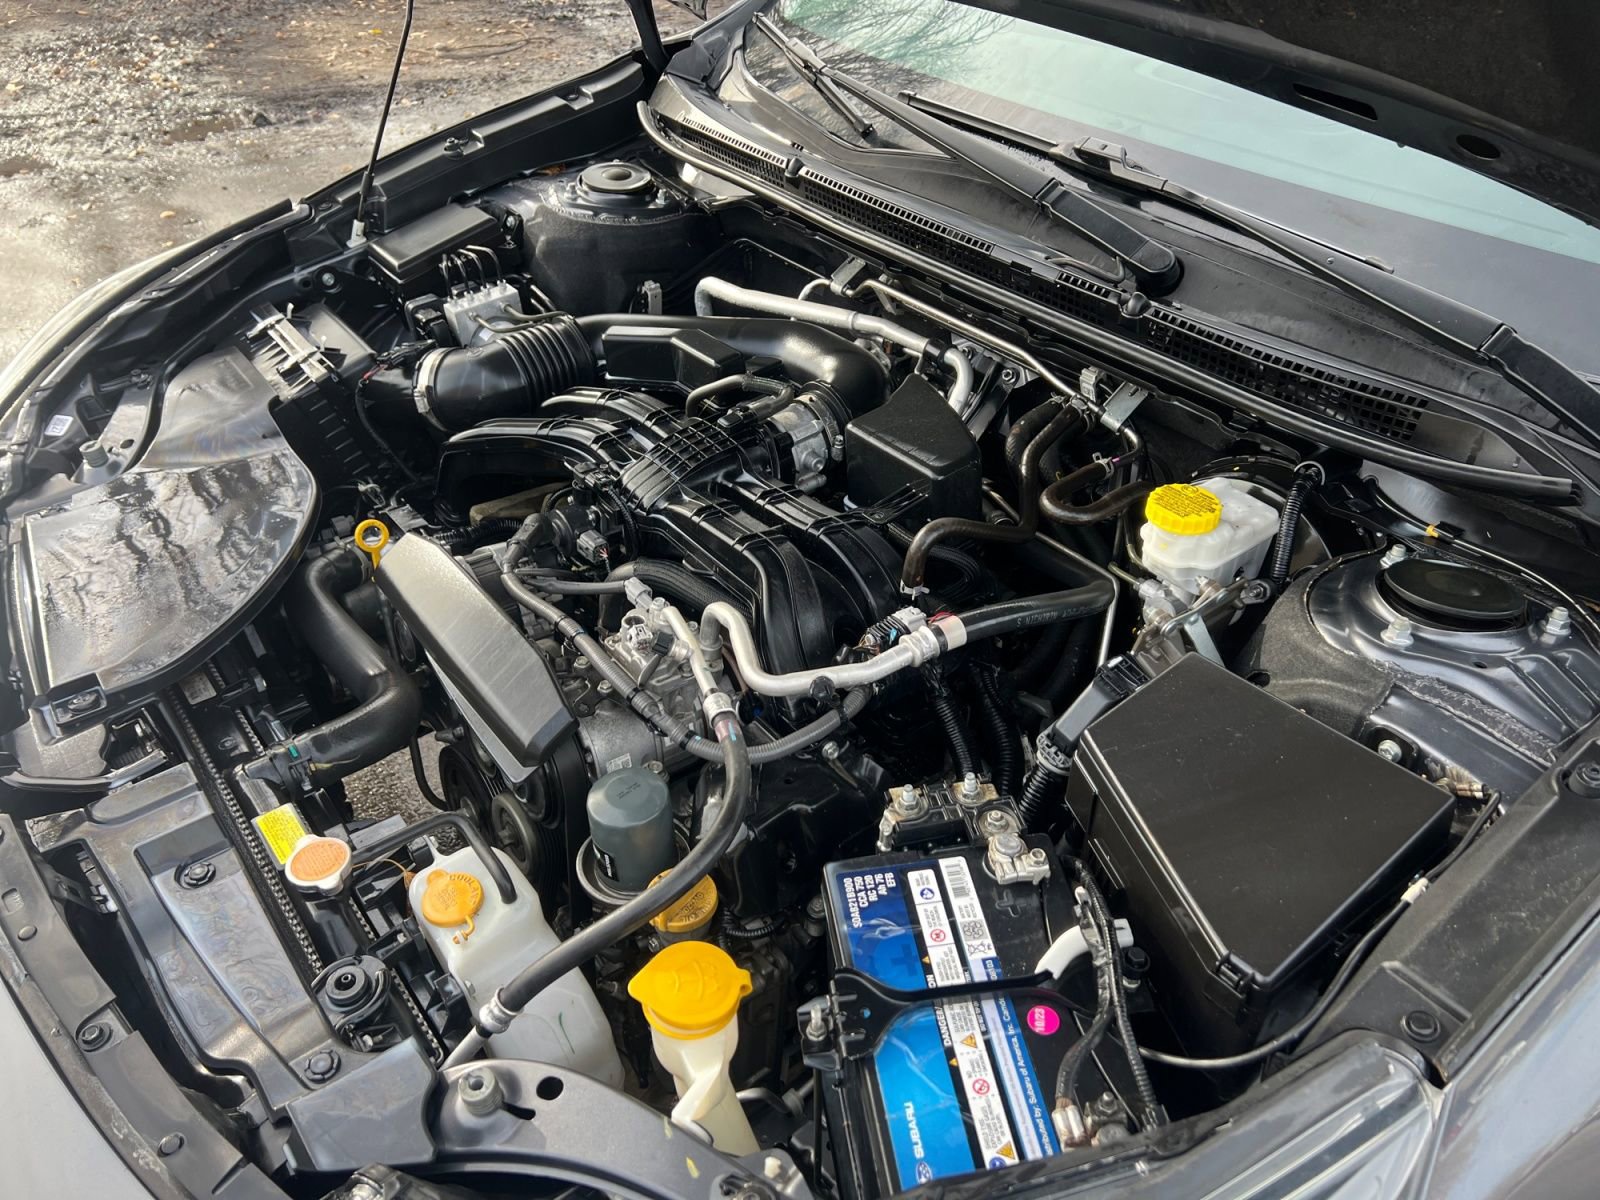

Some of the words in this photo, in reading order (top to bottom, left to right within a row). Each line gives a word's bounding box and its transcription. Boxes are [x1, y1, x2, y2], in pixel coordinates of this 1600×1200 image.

[854, 876, 865, 891] 750
[864, 874, 875, 889] 120
[874, 873, 885, 885] 76
[884, 872, 897, 888] EFB
[867, 889, 879, 902] RC
[877, 884, 888, 896] Ah
[857, 891, 869, 908] CCA
[1020, 1067, 1029, 1077] of
[1023, 1076, 1038, 1104] Subaru
[903, 1101, 925, 1159] SUBARU
